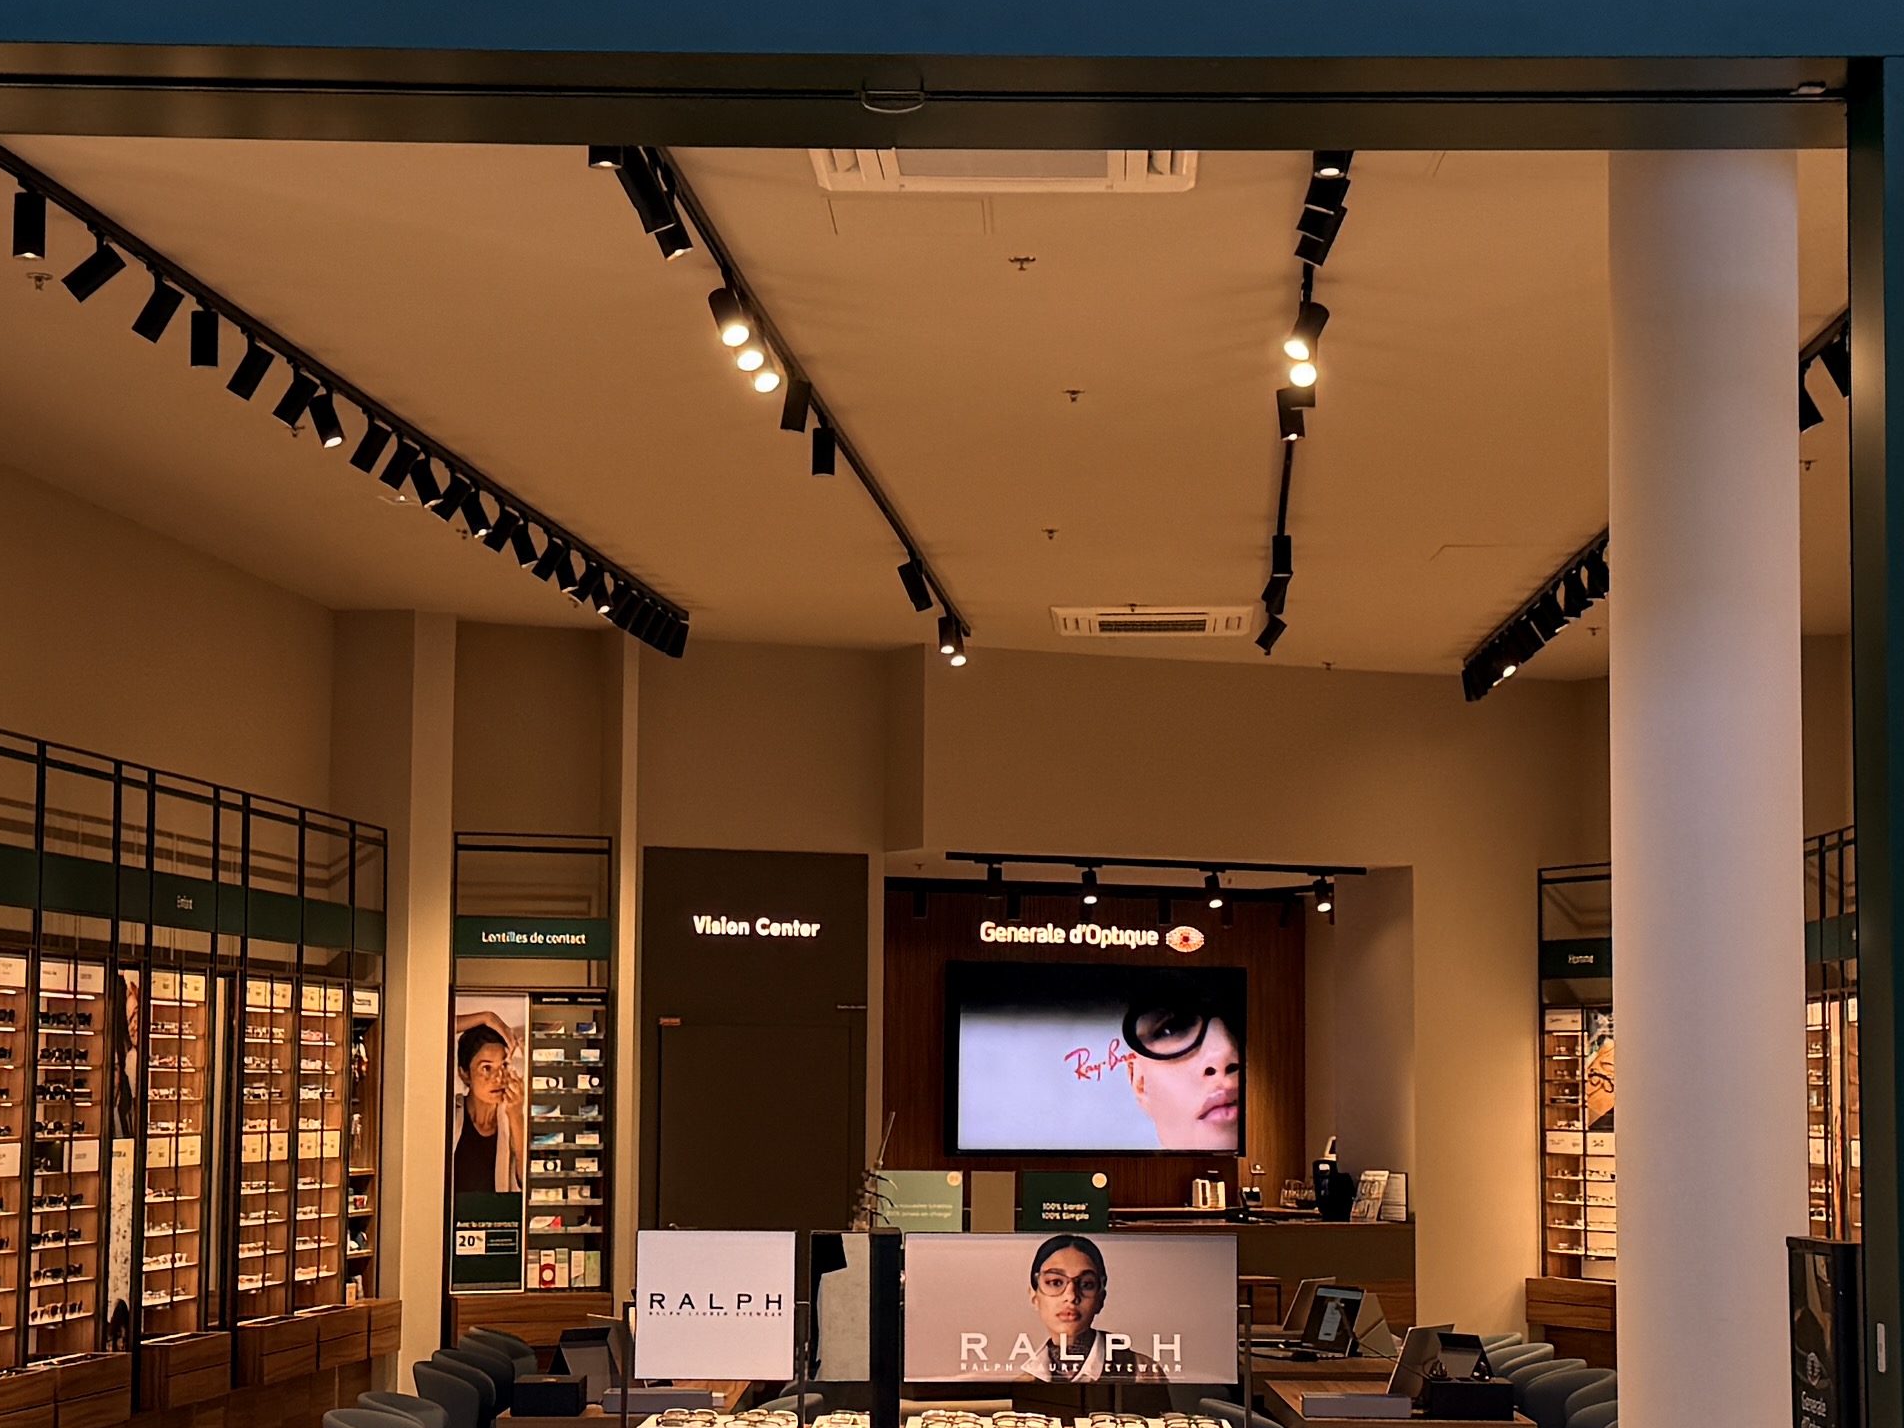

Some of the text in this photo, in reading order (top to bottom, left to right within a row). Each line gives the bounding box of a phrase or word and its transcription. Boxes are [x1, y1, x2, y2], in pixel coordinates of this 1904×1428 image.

[693, 915, 821, 937] Vision Center
[980, 921, 1159, 949] Generale d'Optique
[529, 932, 544, 944] de
[546, 934, 586, 944] contact
[649, 1293, 782, 1310] RALPH
[960, 1332, 1181, 1362] RALPH
[1105, 1363, 1182, 1373] EYEWEAR
